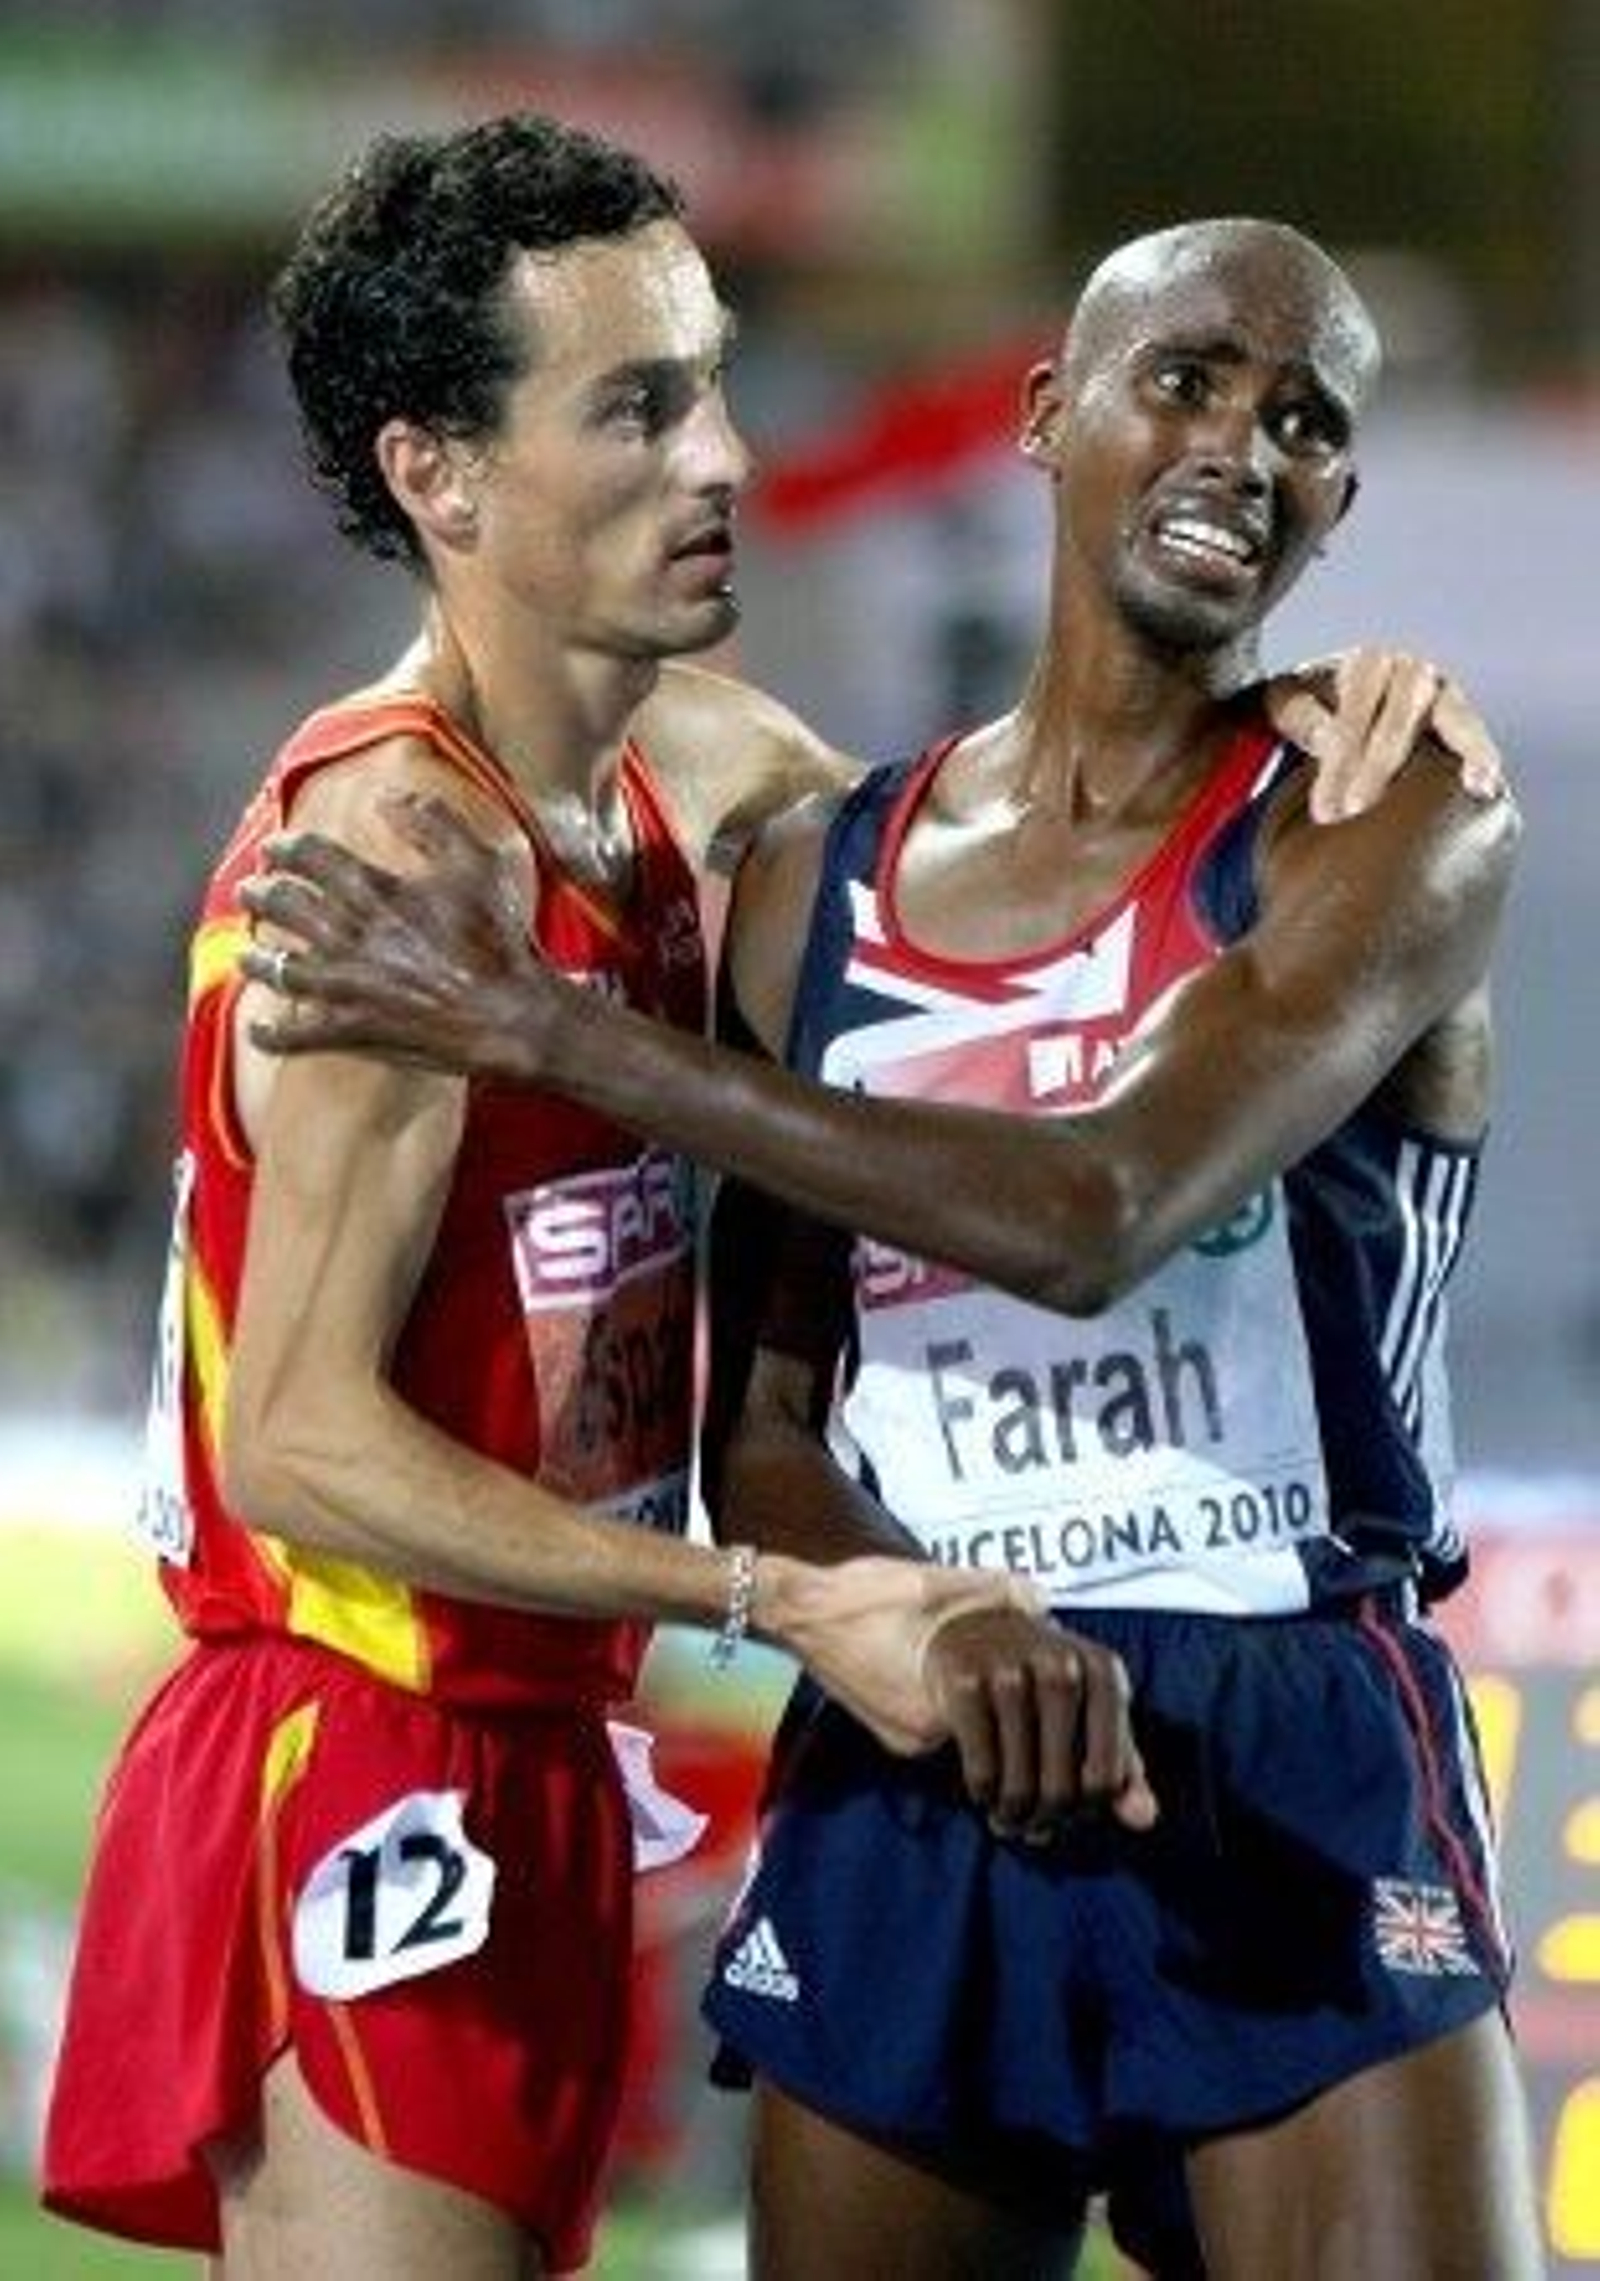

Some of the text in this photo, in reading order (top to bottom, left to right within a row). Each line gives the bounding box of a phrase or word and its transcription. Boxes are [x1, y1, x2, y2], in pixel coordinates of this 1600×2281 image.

[926, 1308, 1223, 1483] Farah
[1199, 1482, 1312, 1548] 2010
[338, 1834, 467, 1960] 12
